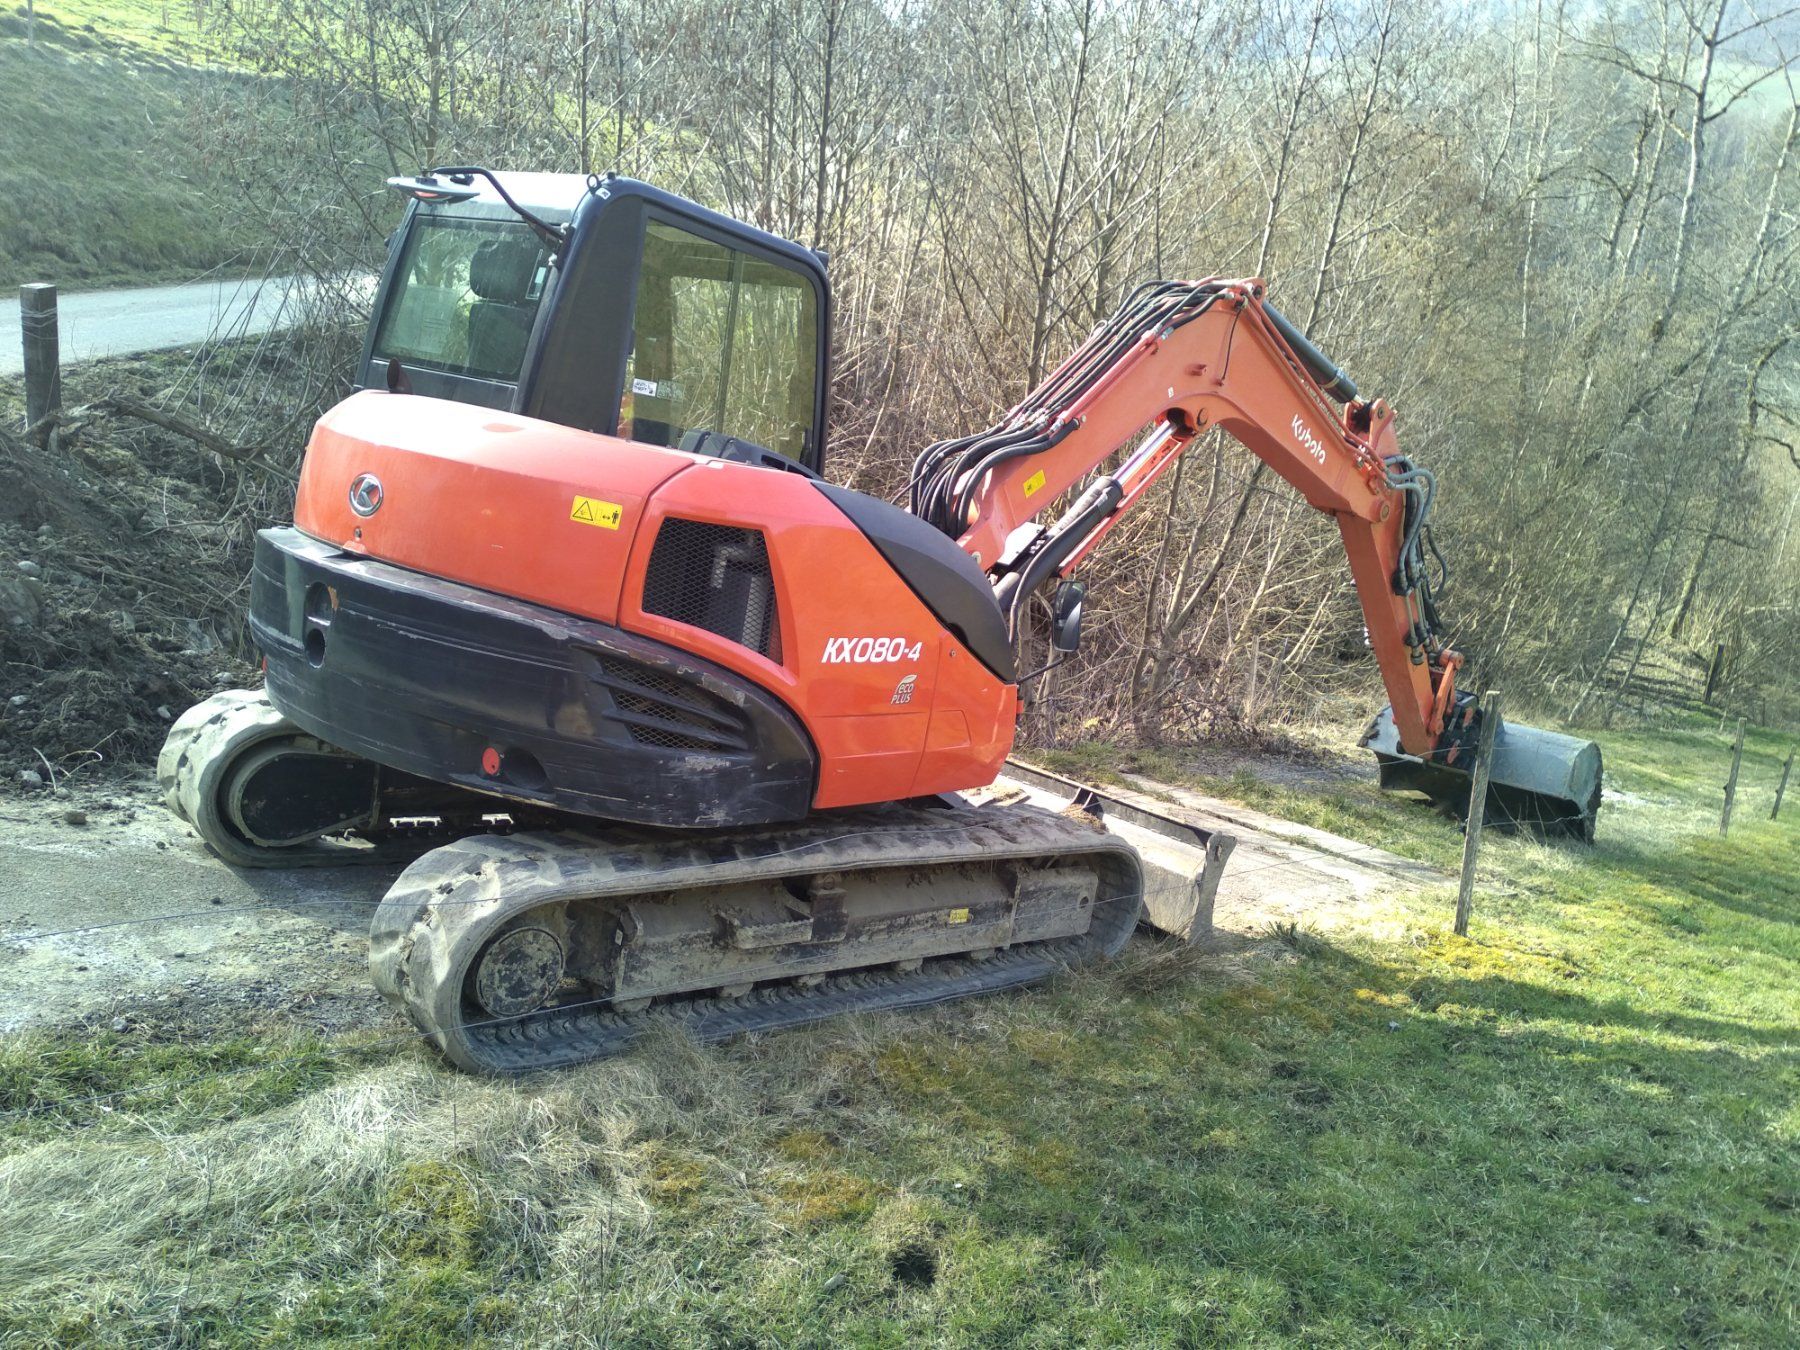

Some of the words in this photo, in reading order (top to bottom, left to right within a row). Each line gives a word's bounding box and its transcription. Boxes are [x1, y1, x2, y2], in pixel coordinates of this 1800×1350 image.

[1291, 413, 1326, 465] Kubota
[821, 637, 923, 663] KX080-4
[898, 683, 914, 694] eco
[890, 693, 911, 705] PLUS
